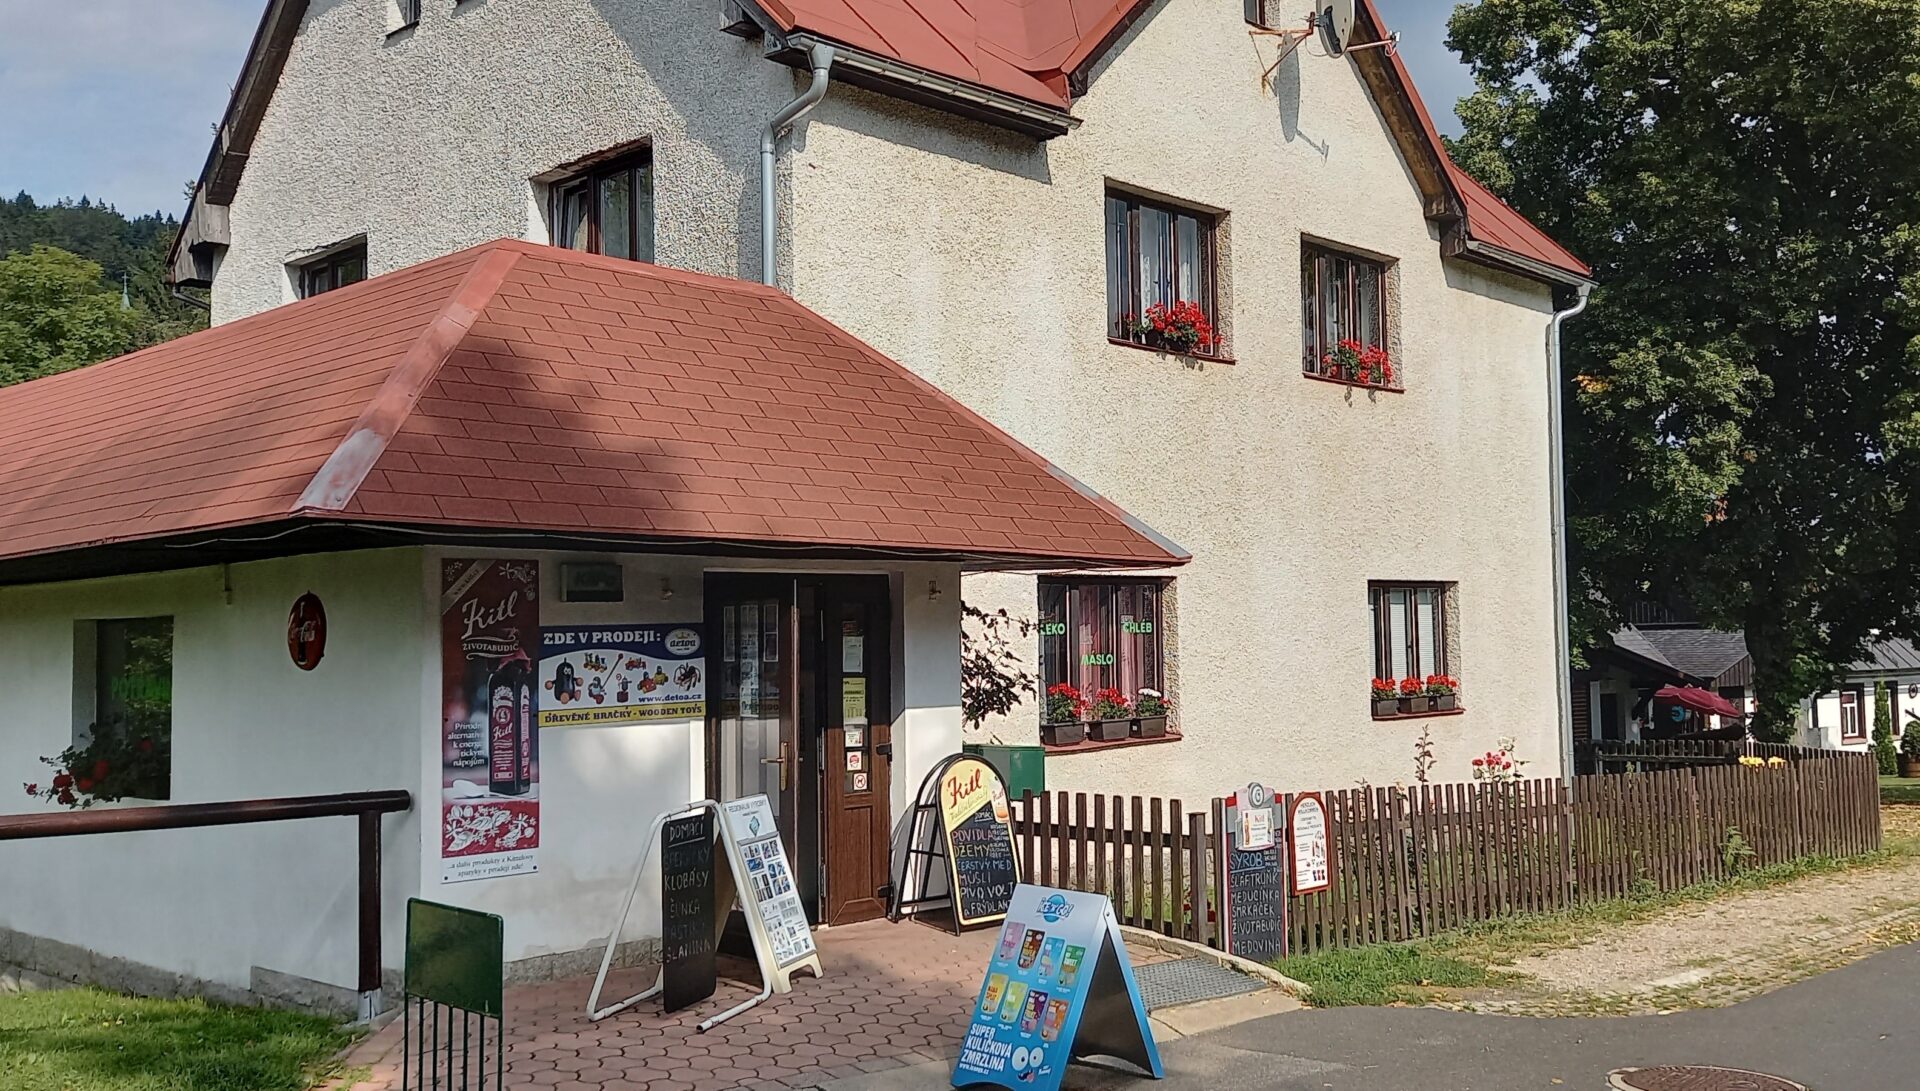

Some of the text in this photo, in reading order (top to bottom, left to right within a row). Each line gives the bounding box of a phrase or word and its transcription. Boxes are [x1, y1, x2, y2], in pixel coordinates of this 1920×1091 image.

[461, 590, 519, 640] Kitl
[1123, 618, 1153, 633] CHLÉB
[543, 629, 662, 645] ZDE V PRODEJI:
[1081, 650, 1115, 666] MÁSLO
[638, 692, 703, 704] www.detoa.cz
[544, 710, 591, 724] DŘEVĚNÉ
[639, 705, 679, 718] WOODEN
[680, 702, 703, 716] TOYS
[948, 768, 983, 811] Kitl
[669, 815, 705, 842] DOMÁCÍ
[951, 827, 994, 843] POVIDLA
[953, 842, 990, 859] DŽEMY
[664, 868, 709, 891] KLOBÁSY
[960, 880, 1014, 899] PIVO VOLT
[1231, 915, 1282, 936] ŽIVOTABUDIČ
[1232, 936, 1282, 956] MEDOVINA
[970, 1023, 996, 1039] SUPER
[965, 1035, 1013, 1059] KULIČKOVÁ
[961, 1049, 1006, 1073] ZMRZLINA
